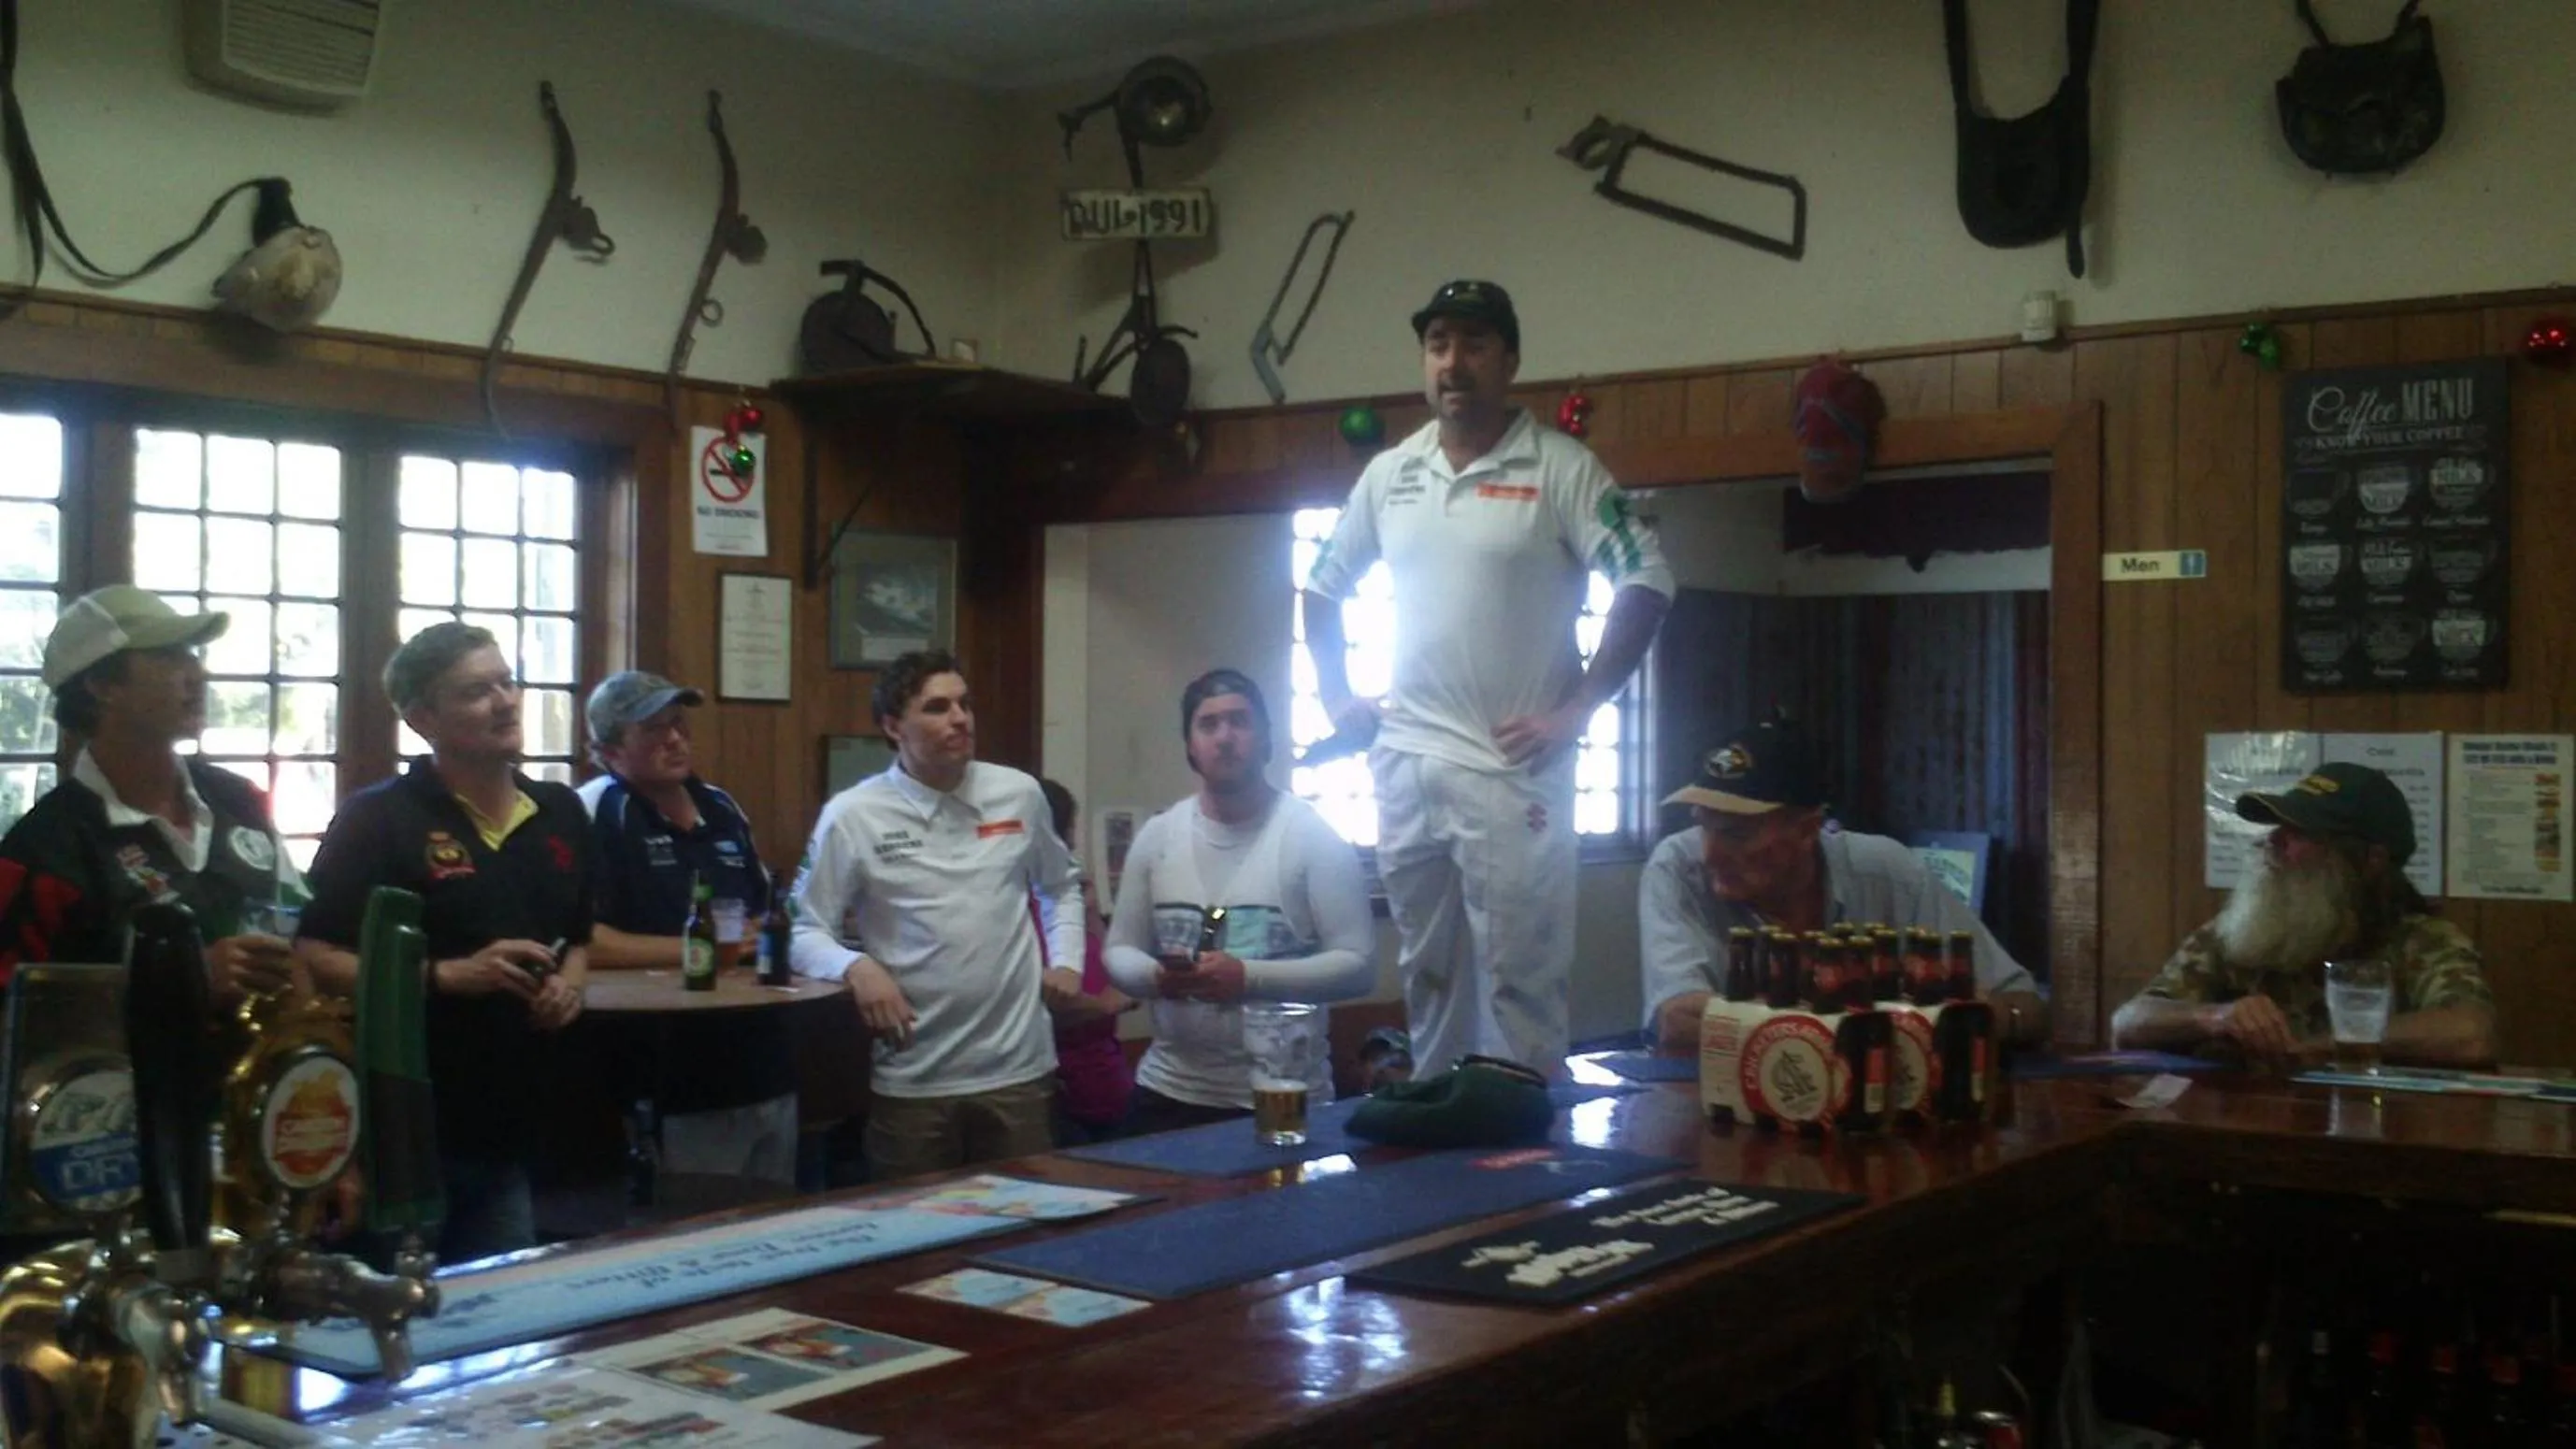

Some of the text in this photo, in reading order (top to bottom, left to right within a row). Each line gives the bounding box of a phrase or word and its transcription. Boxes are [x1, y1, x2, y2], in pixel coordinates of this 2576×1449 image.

[2308, 378, 2474, 440] Coffee MENU
[2120, 557, 2161, 574] Men
